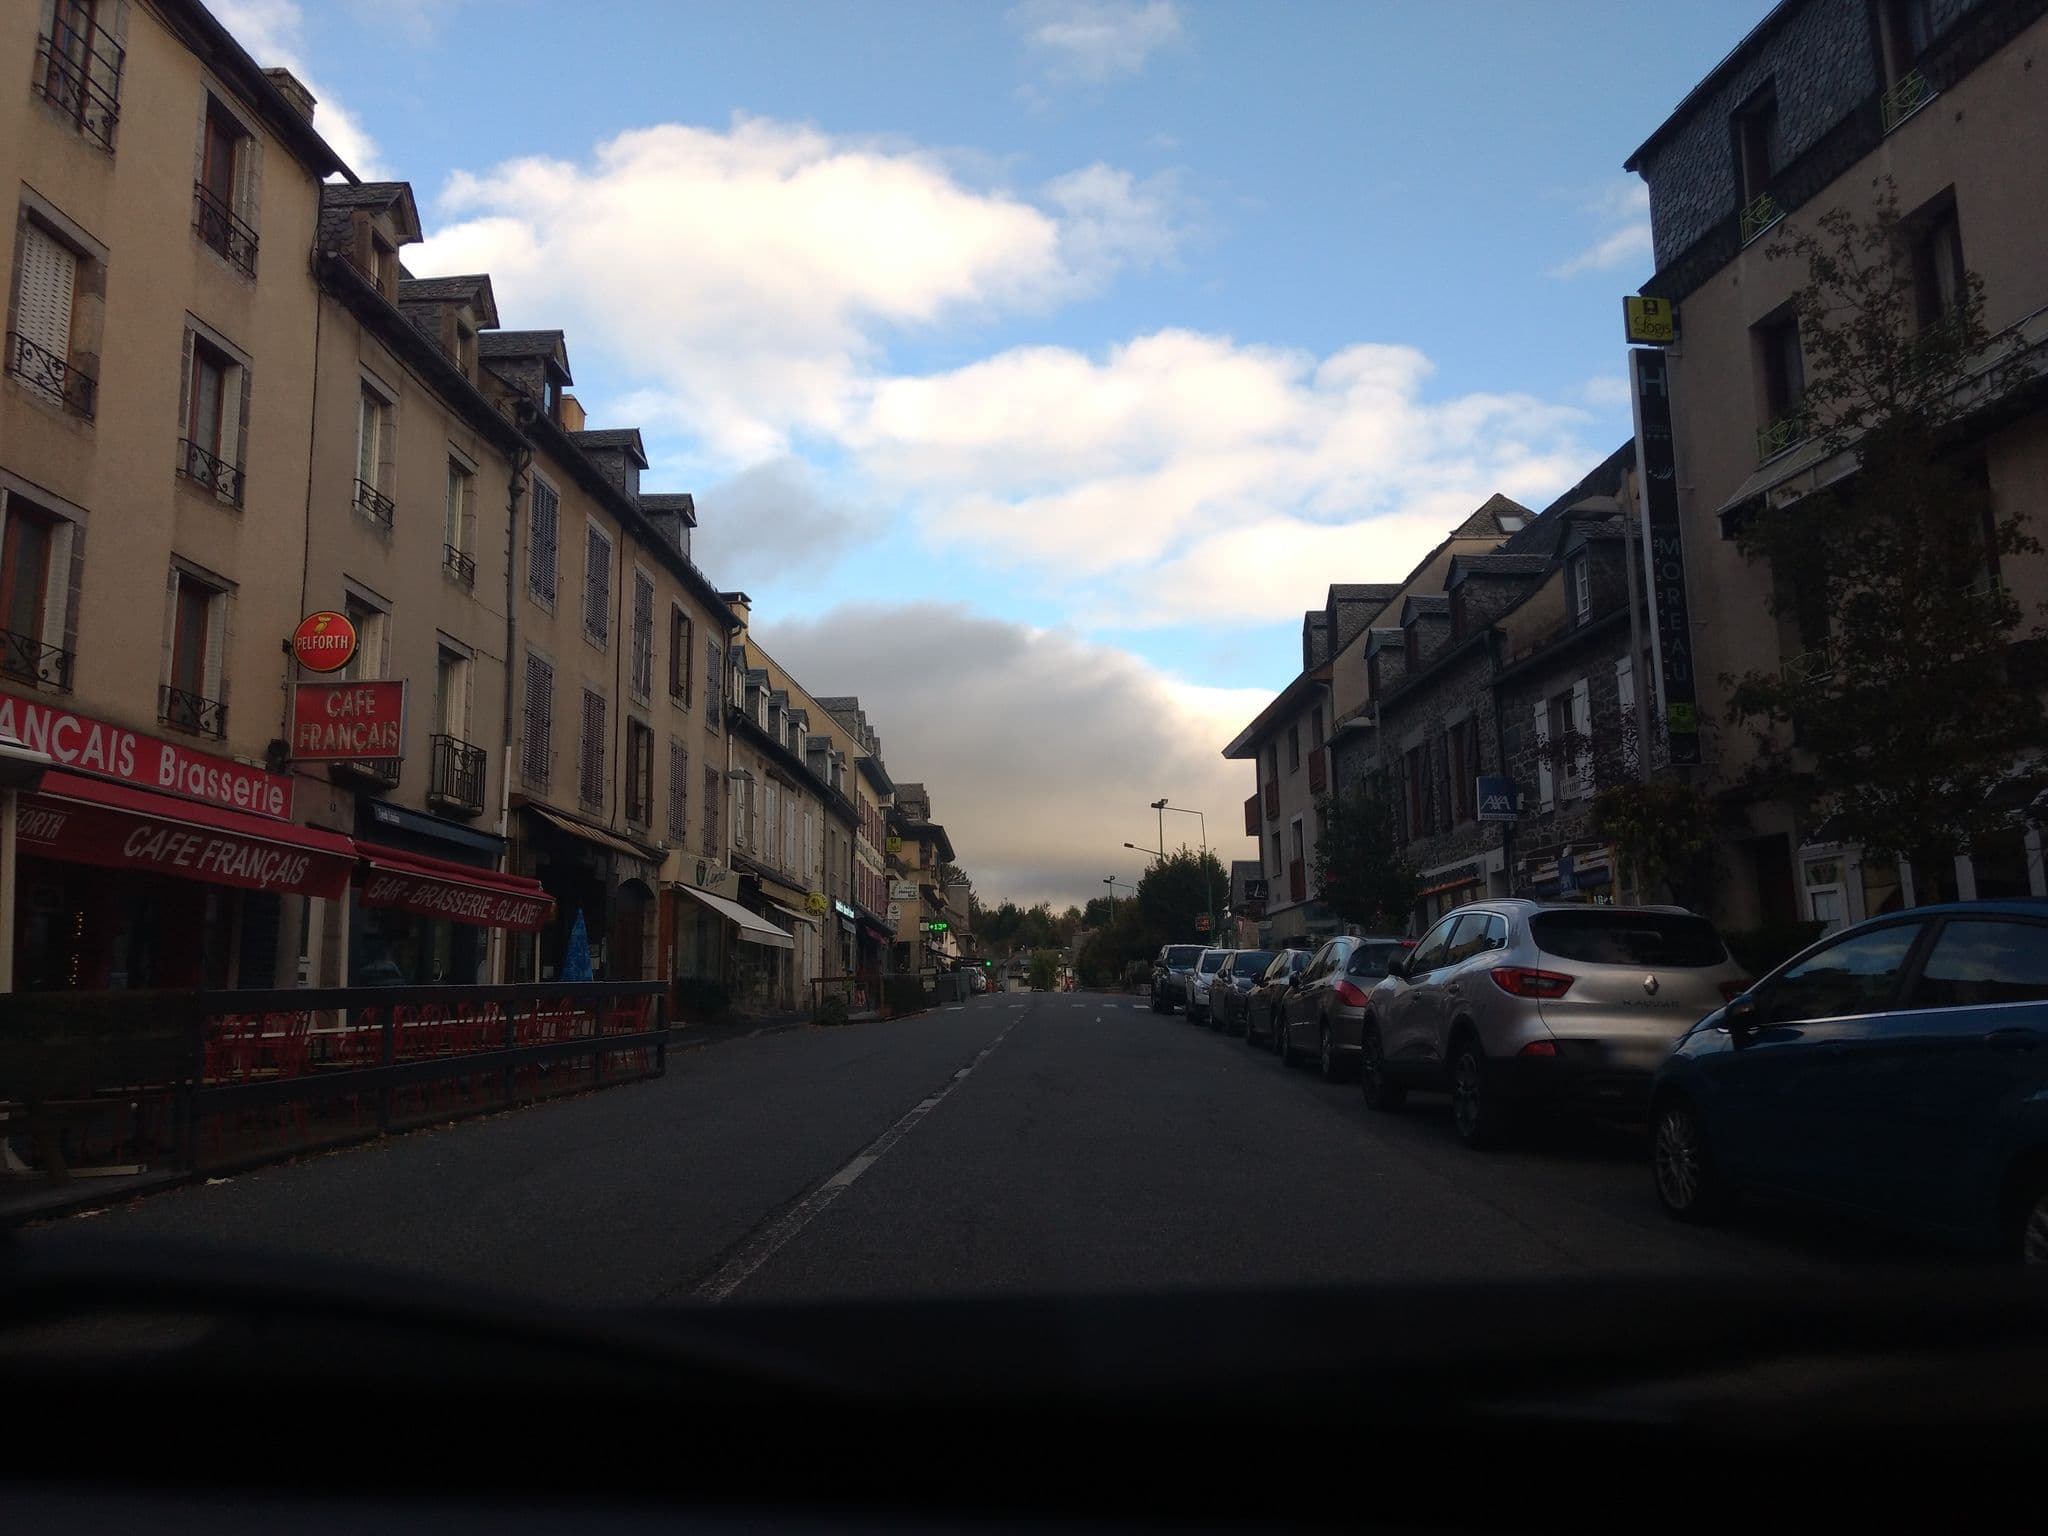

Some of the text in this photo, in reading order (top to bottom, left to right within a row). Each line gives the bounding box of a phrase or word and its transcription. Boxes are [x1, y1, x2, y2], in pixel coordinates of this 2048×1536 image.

[1659, 536, 1688, 681] MOREAU
[297, 635, 349, 650] PELFORTH
[325, 689, 376, 718] CAFE
[299, 720, 399, 753] FRANÇAIS
[159, 744, 285, 815] Brasserie
[1481, 794, 1512, 810] AXA
[123, 825, 311, 888] CAFE FRANÇAIS
[408, 884, 494, 920] BRASSERIE
